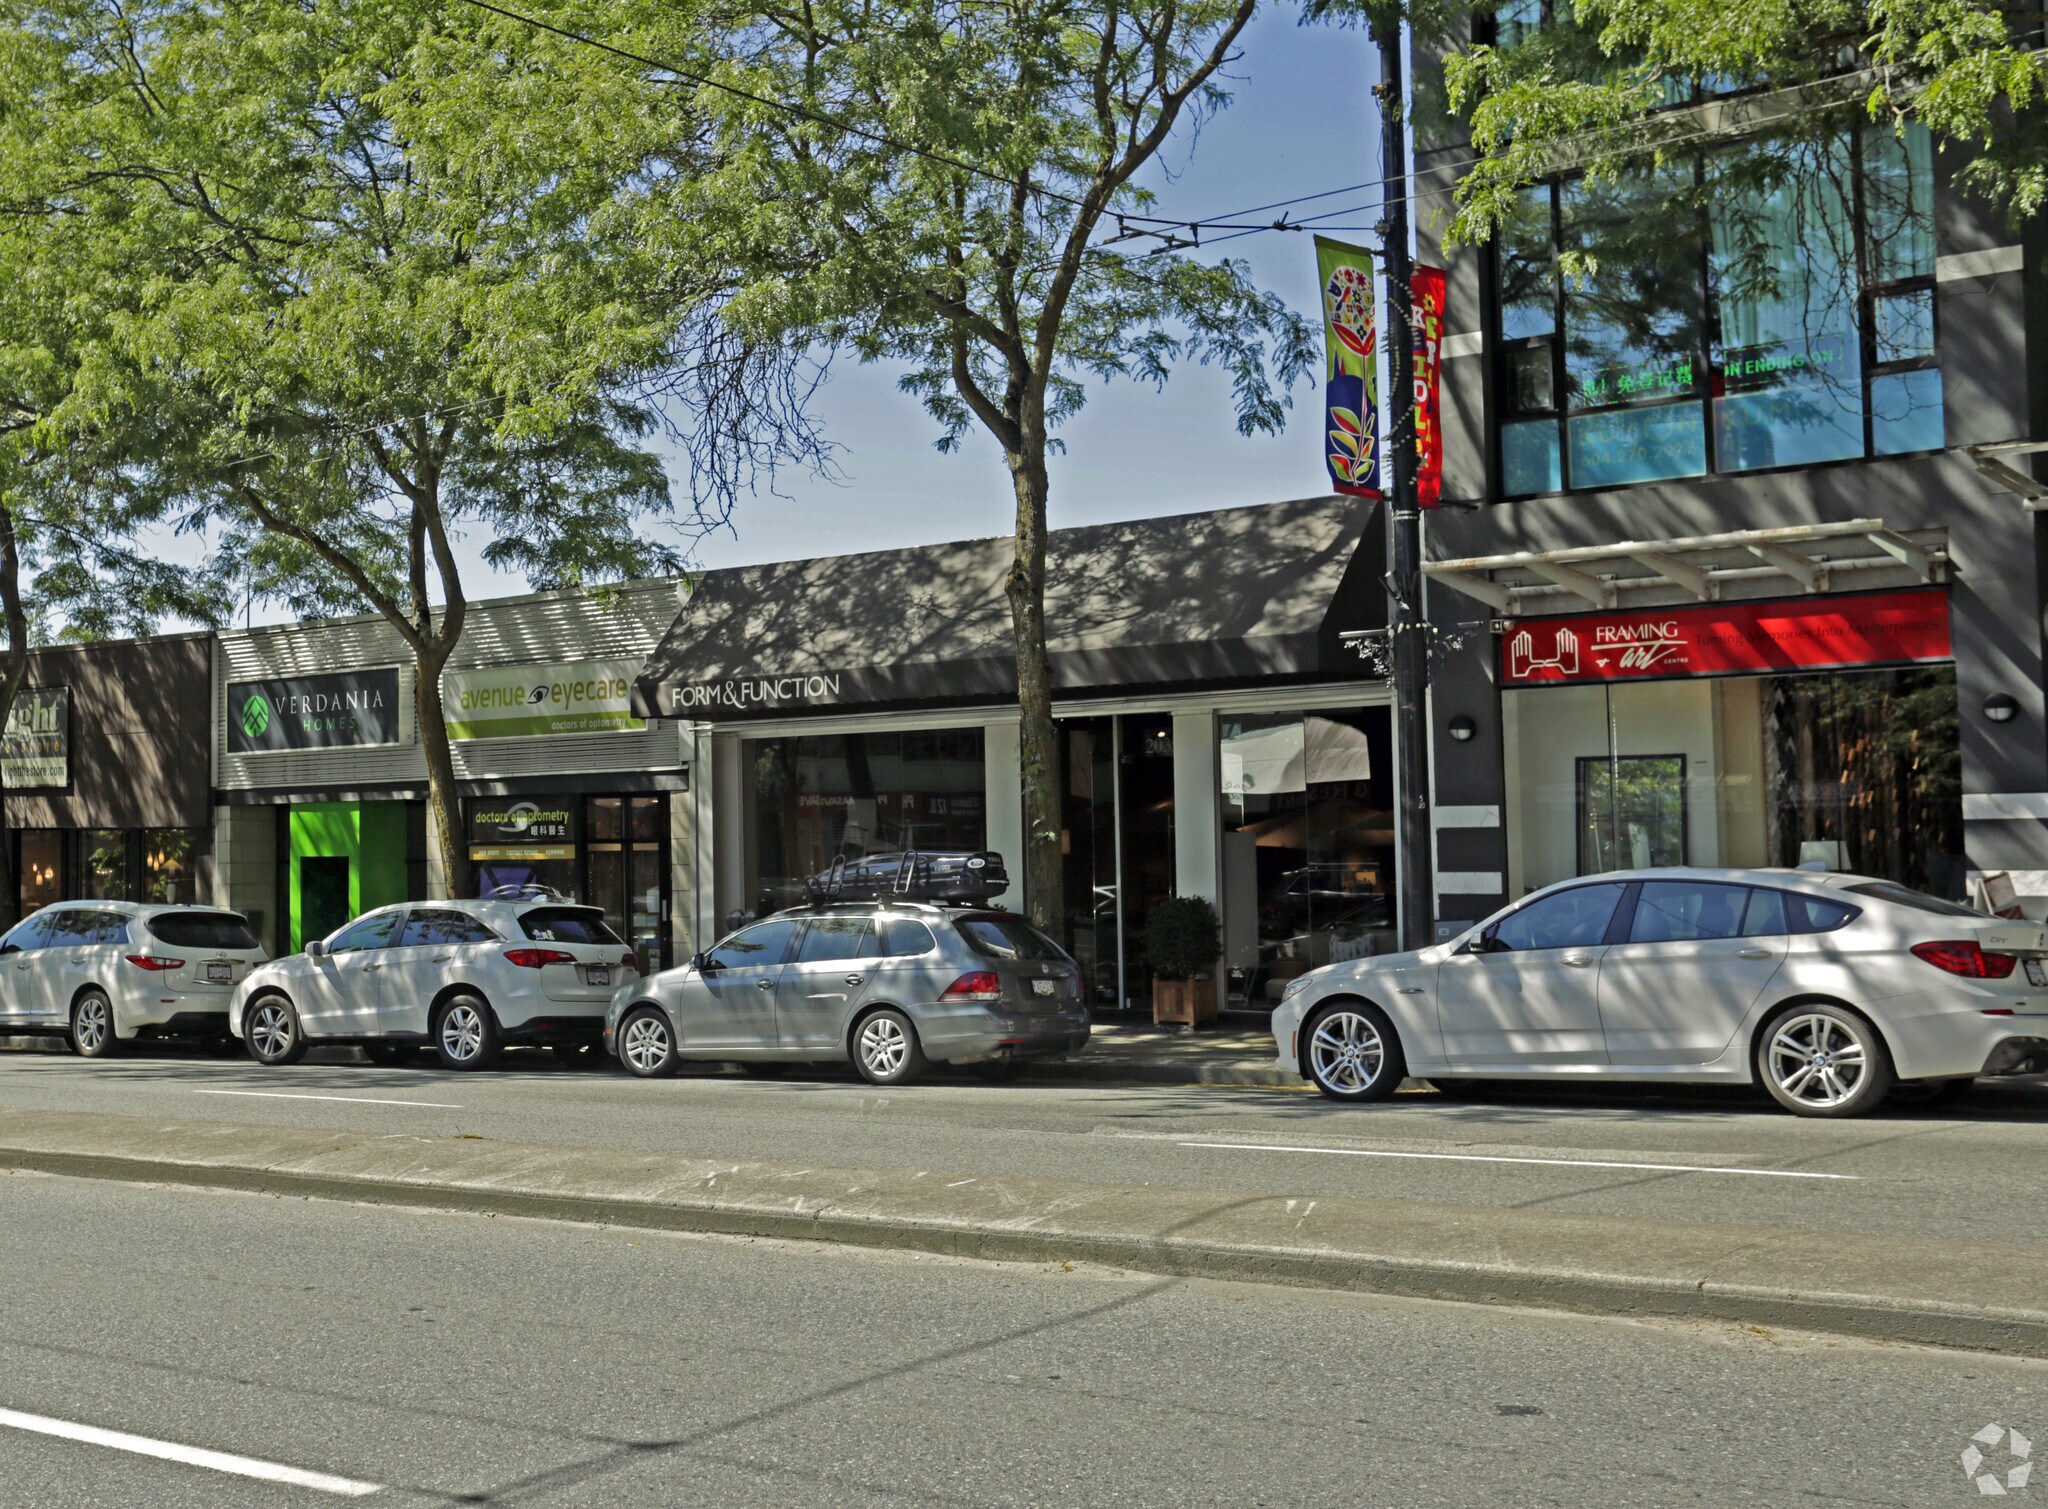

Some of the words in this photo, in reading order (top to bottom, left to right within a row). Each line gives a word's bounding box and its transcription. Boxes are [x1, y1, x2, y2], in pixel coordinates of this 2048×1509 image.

[1745, 353, 1805, 375] ENDING
[1811, 348, 1834, 364] ON
[1596, 621, 1678, 642] FRAMING
[1817, 626, 1843, 638] Into
[1663, 657, 1689, 665] CENTRE
[460, 683, 526, 711] avenue
[550, 676, 628, 711] eyecare
[671, 683, 721, 709] FORM
[722, 679, 747, 709] &
[740, 674, 840, 703] FUNCTION
[275, 689, 384, 715] VERDANIA
[4, 696, 60, 742] ight
[303, 715, 357, 733] HOMES
[551, 718, 577, 731] doctors
[580, 718, 588, 730] of
[589, 715, 627, 732] optometry
[1145, 737, 1174, 754] 203
[475, 811, 508, 824] doctors
[511, 811, 520, 823] of
[523, 809, 569, 825] optometry
